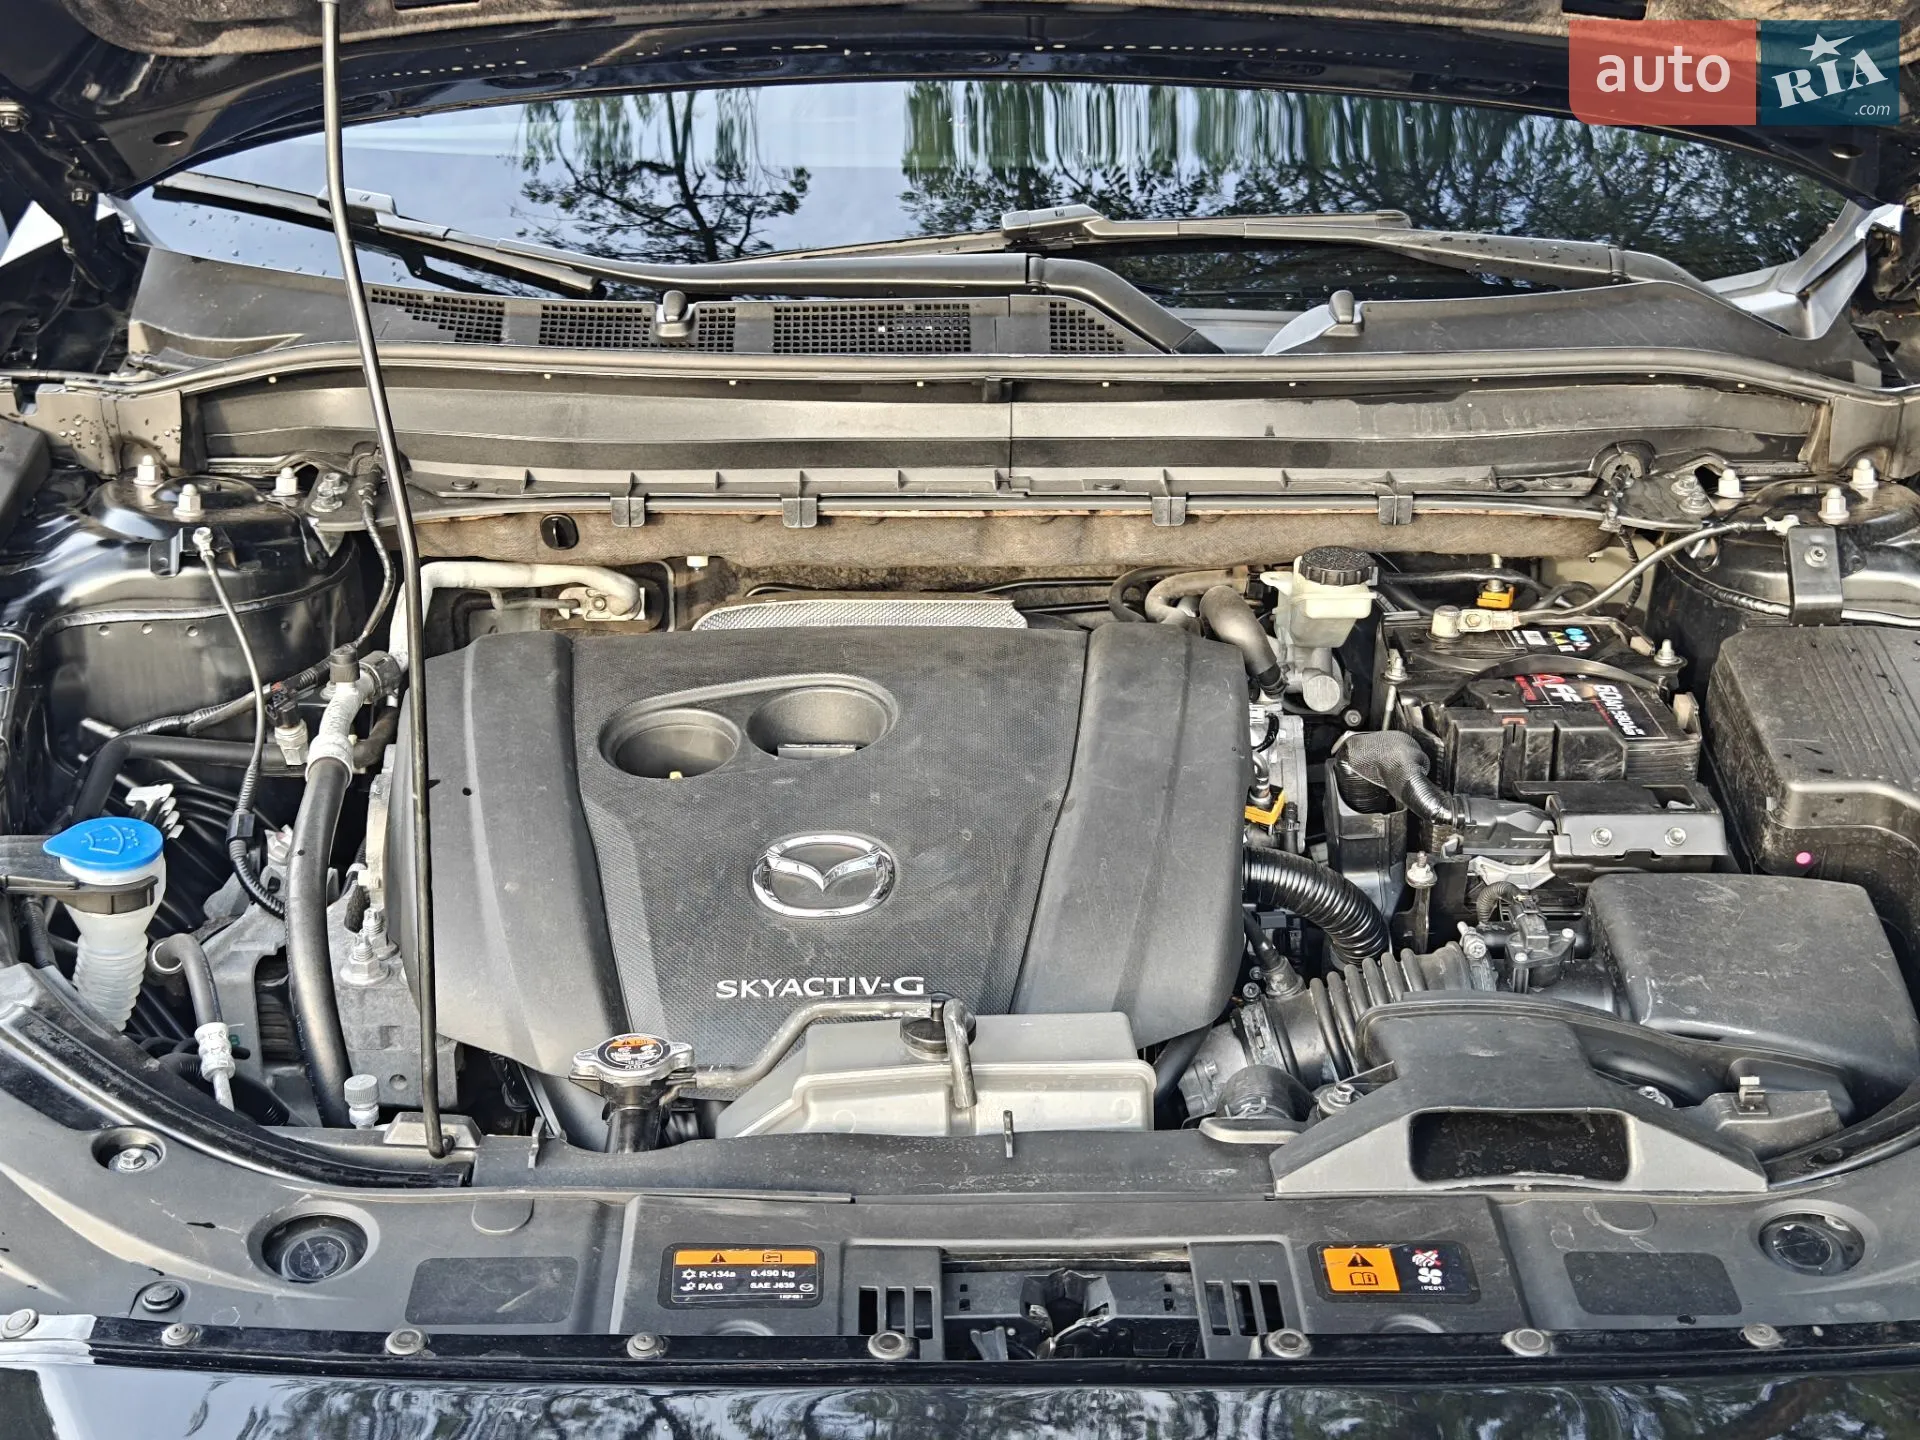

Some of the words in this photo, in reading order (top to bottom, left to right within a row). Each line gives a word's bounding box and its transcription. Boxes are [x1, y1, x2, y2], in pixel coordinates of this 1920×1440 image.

[715, 976, 925, 999] SKYACTIV-G
[781, 1269, 796, 1279] kg
[698, 1282, 722, 1290] PAG
